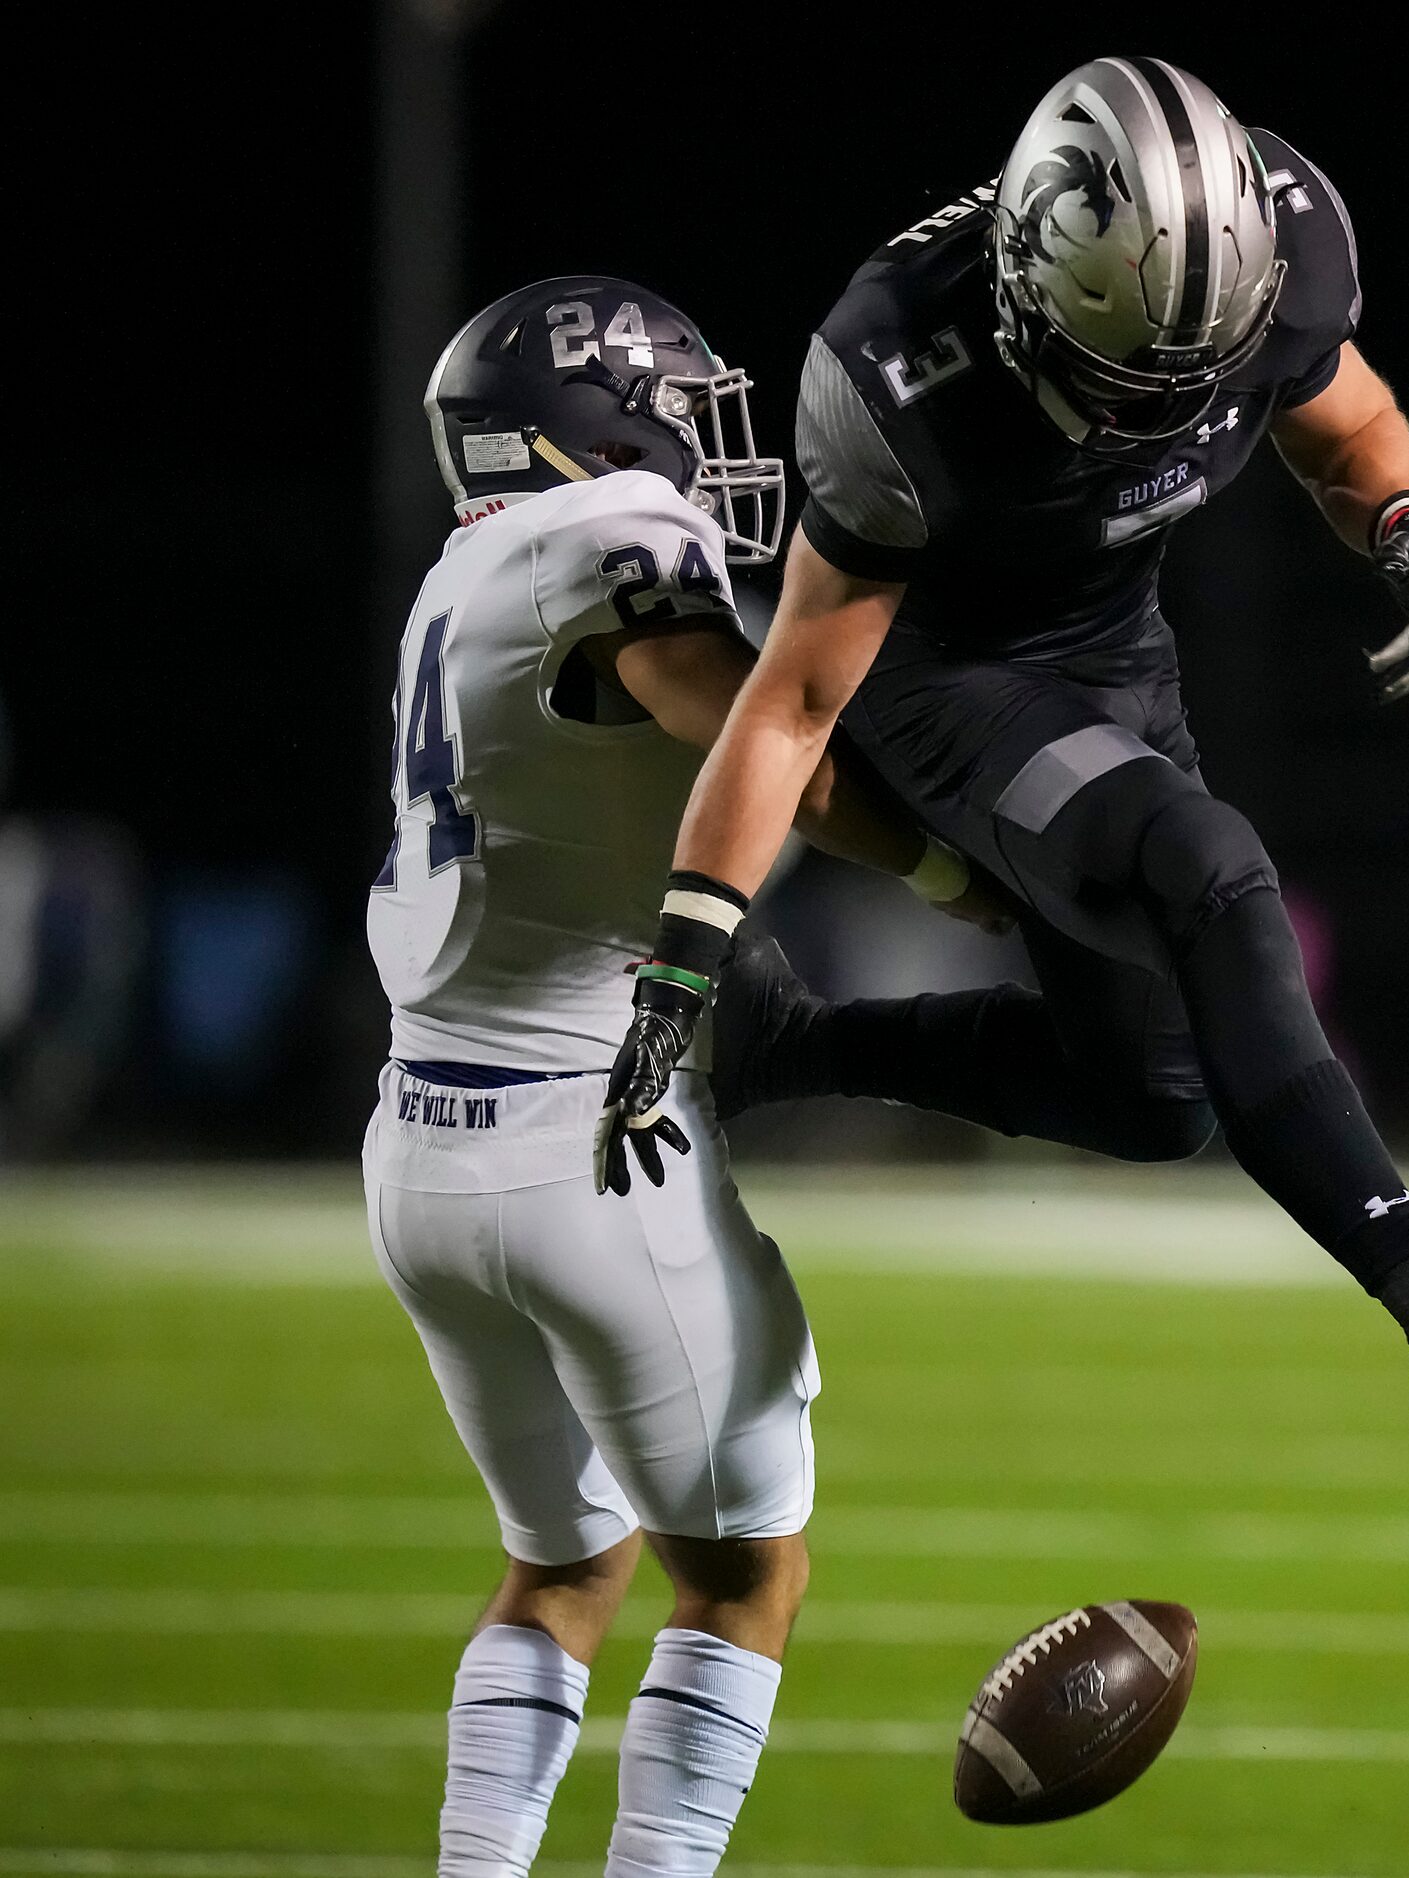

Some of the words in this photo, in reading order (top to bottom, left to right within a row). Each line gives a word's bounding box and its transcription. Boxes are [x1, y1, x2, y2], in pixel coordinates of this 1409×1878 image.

[545, 301, 655, 369] 24
[878, 325, 972, 409] 3
[1118, 461, 1190, 510] GUYER
[595, 537, 724, 631] 24
[398, 1090, 421, 1122] WE
[422, 1095, 457, 1128] WILL
[464, 1097, 498, 1129] WIN
